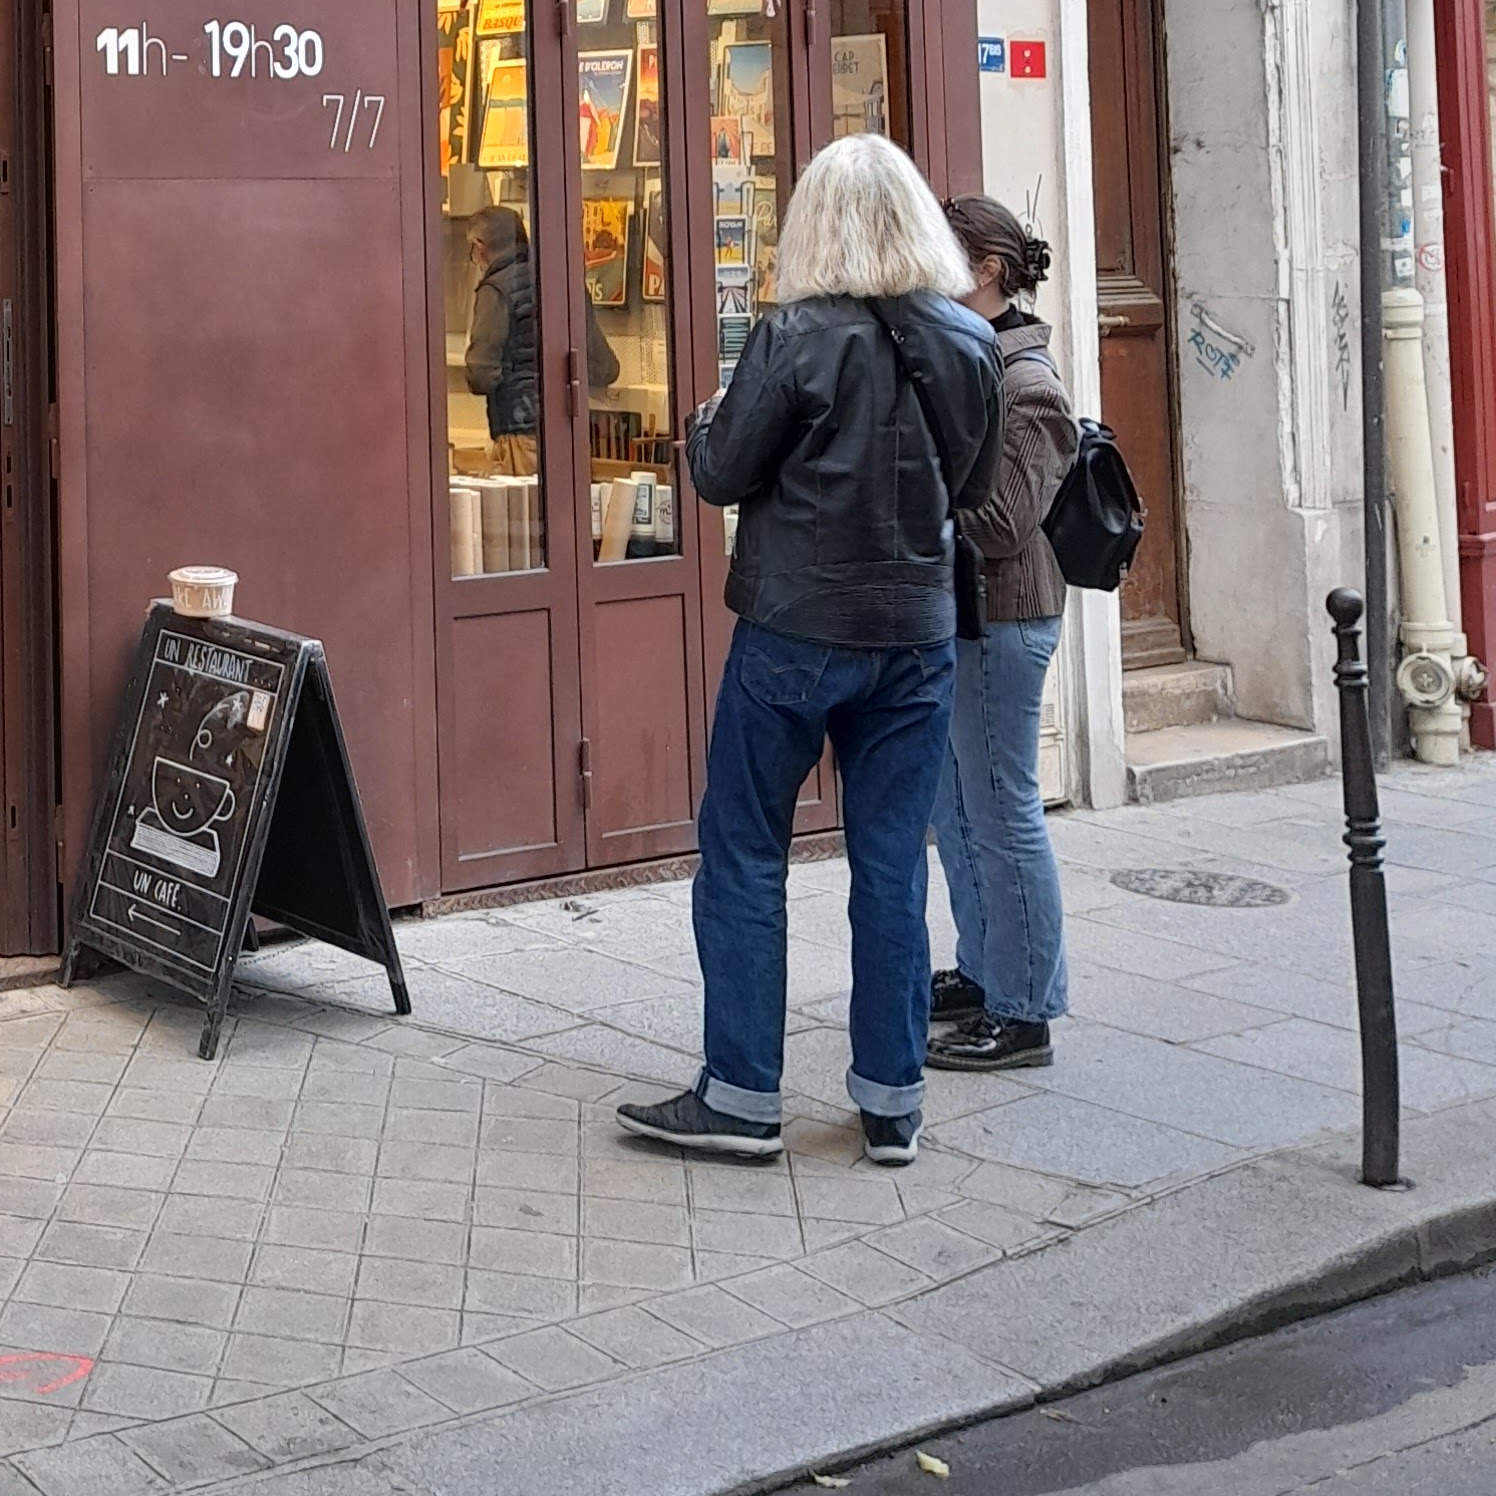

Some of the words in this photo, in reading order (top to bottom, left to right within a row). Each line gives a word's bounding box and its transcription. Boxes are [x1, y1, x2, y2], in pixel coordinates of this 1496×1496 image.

[203, 18, 324, 80] 19h30
[322, 89, 385, 153] 7/7
[164, 638, 181, 662] UN
[133, 869, 153, 894] UN
